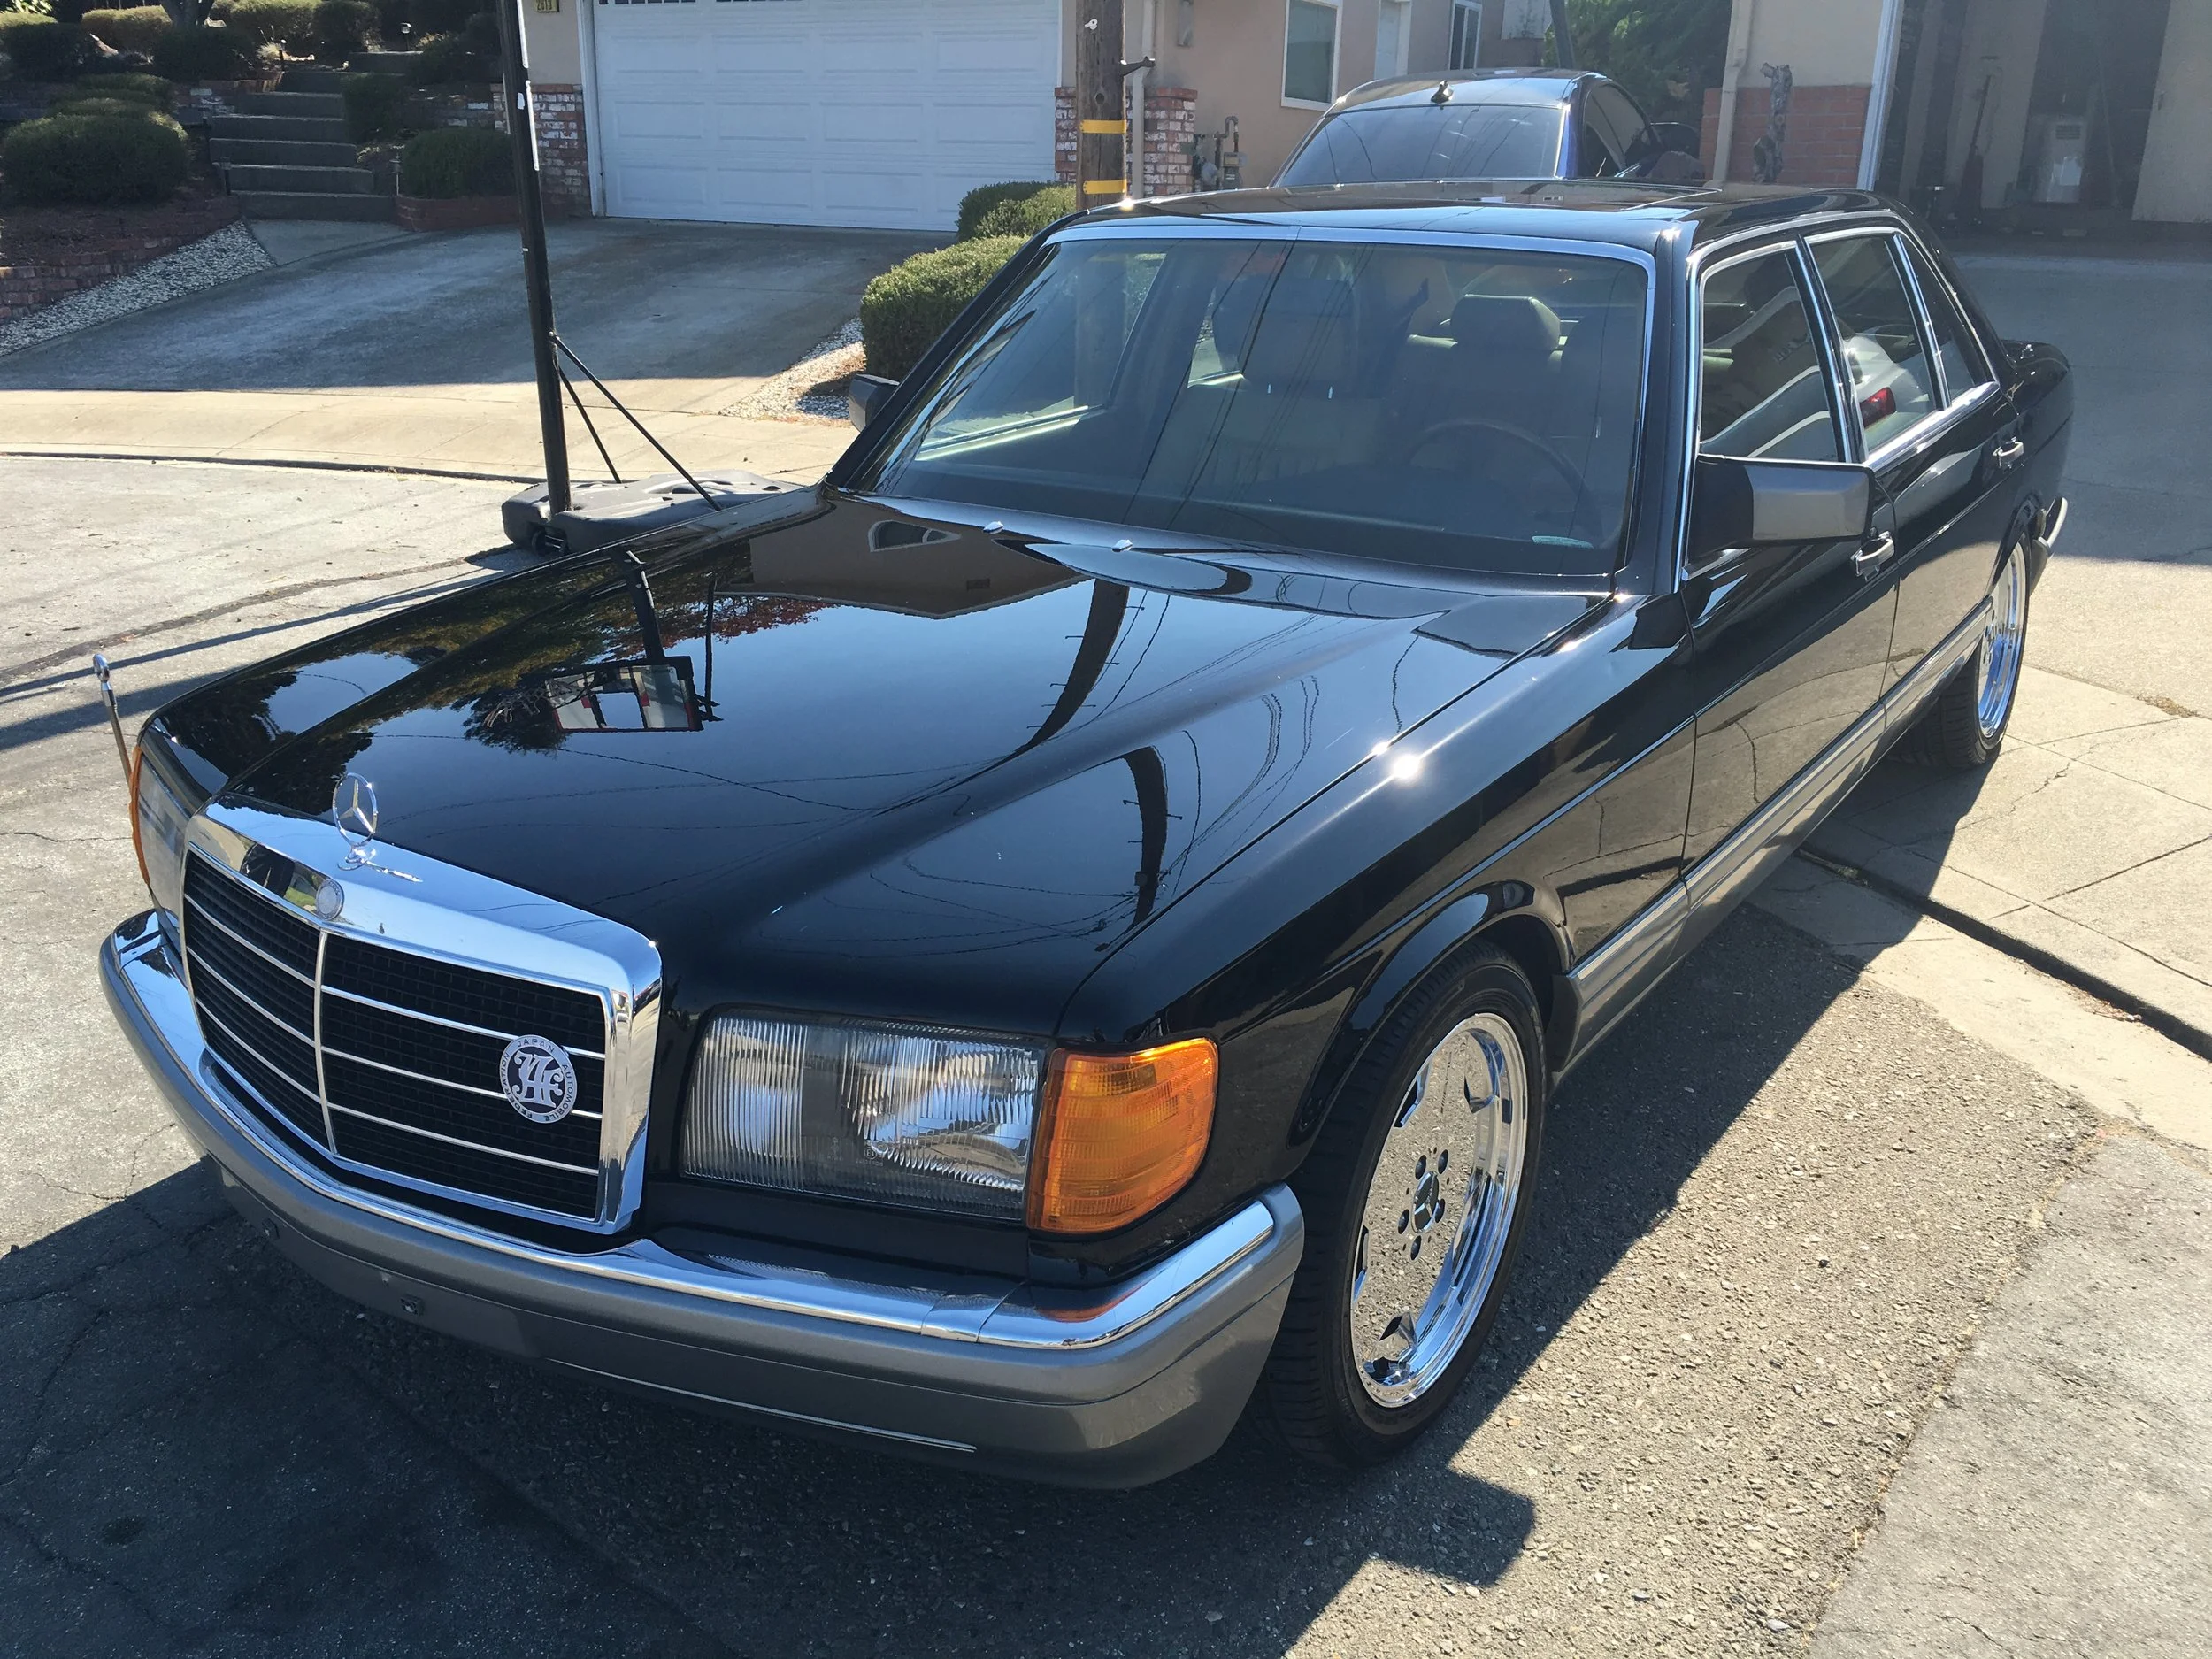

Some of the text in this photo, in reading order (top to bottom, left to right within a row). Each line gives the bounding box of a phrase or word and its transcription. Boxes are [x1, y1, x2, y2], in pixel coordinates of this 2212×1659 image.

[501, 1038, 574, 1122] JAPAN AUTOMOBILE FEDERATION
